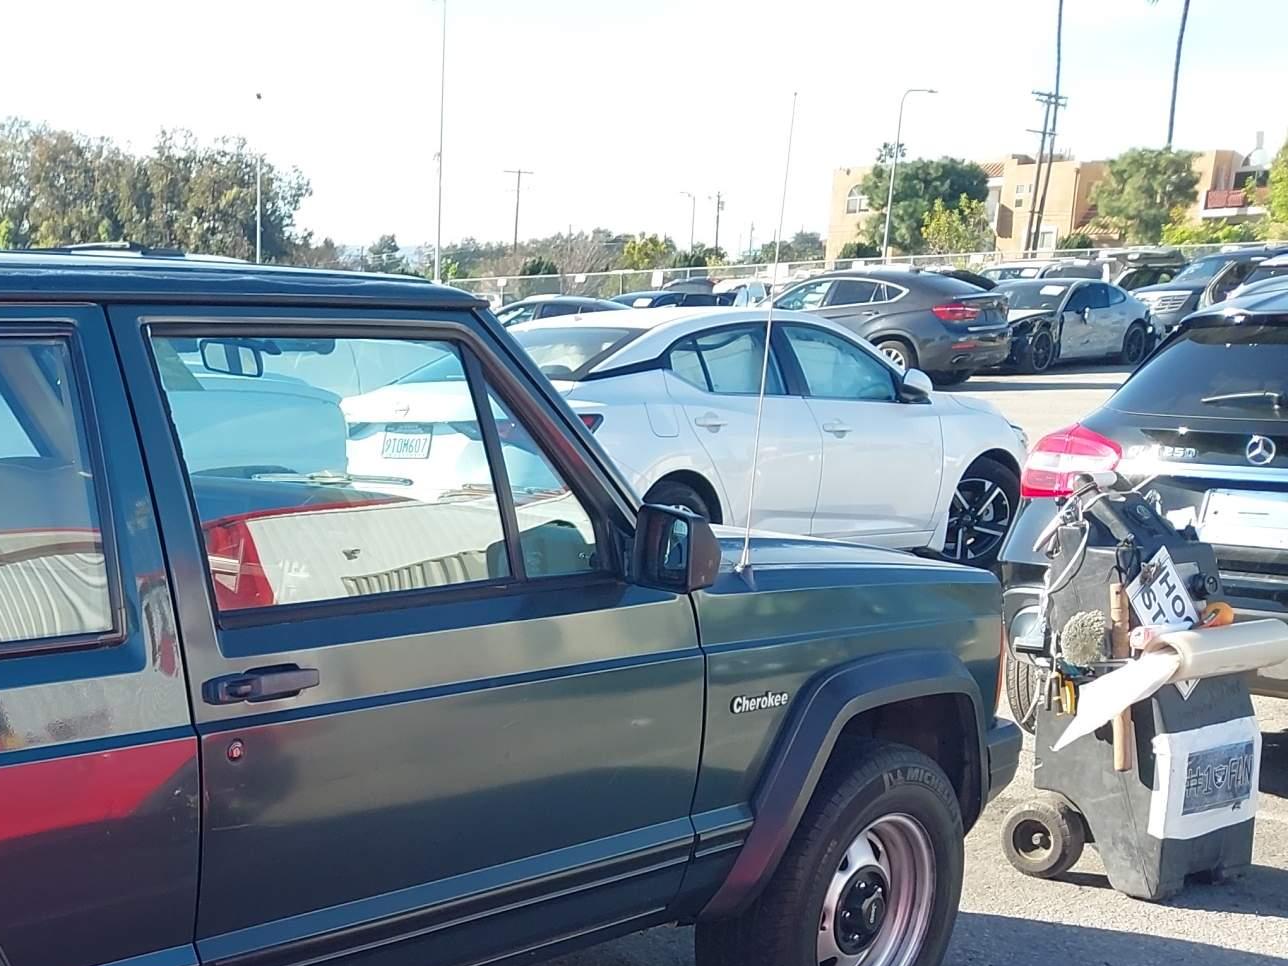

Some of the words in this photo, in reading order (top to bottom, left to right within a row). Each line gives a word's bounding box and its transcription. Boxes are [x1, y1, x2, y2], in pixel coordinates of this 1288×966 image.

[1141, 587, 1170, 624] ST
[732, 691, 789, 714] Cherokee
[1185, 764, 1213, 798] #1
[1227, 753, 1255, 793] FAN
